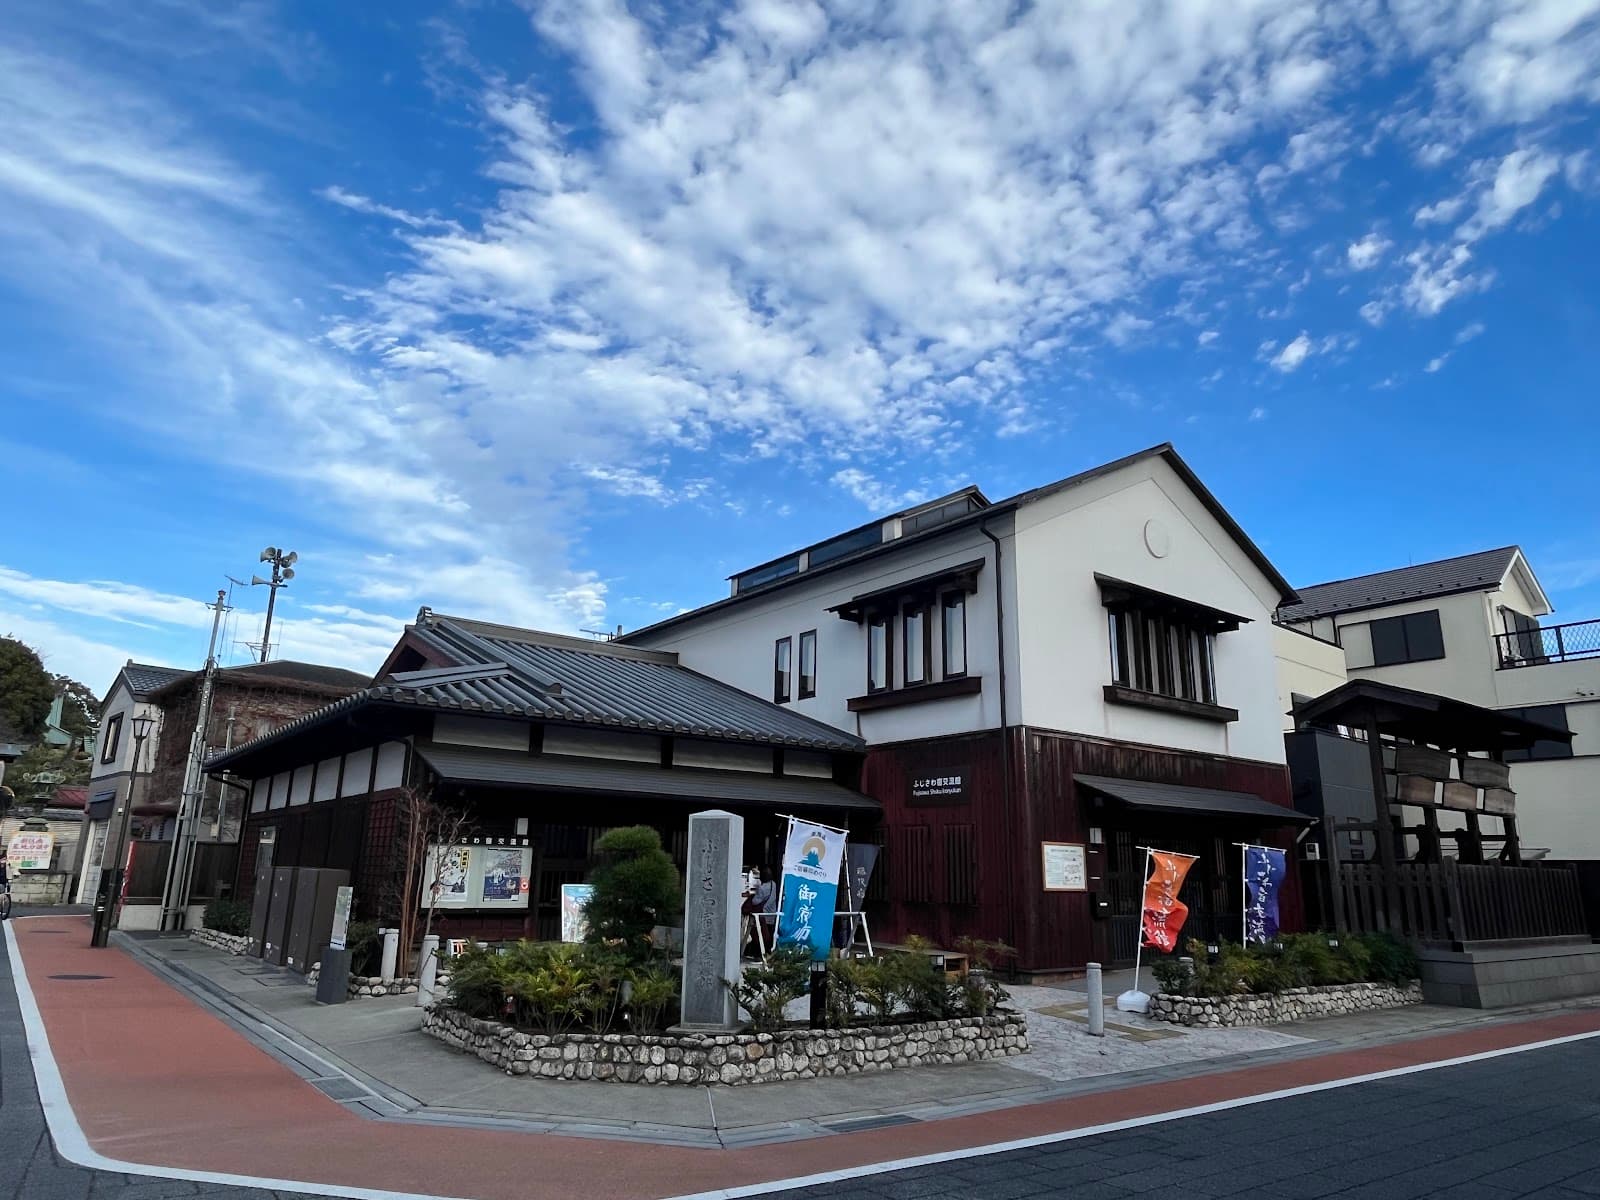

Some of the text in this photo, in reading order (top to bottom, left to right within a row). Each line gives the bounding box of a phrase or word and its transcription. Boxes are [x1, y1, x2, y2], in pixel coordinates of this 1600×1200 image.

[913, 776, 962, 788] ふじさわ宿交流館
